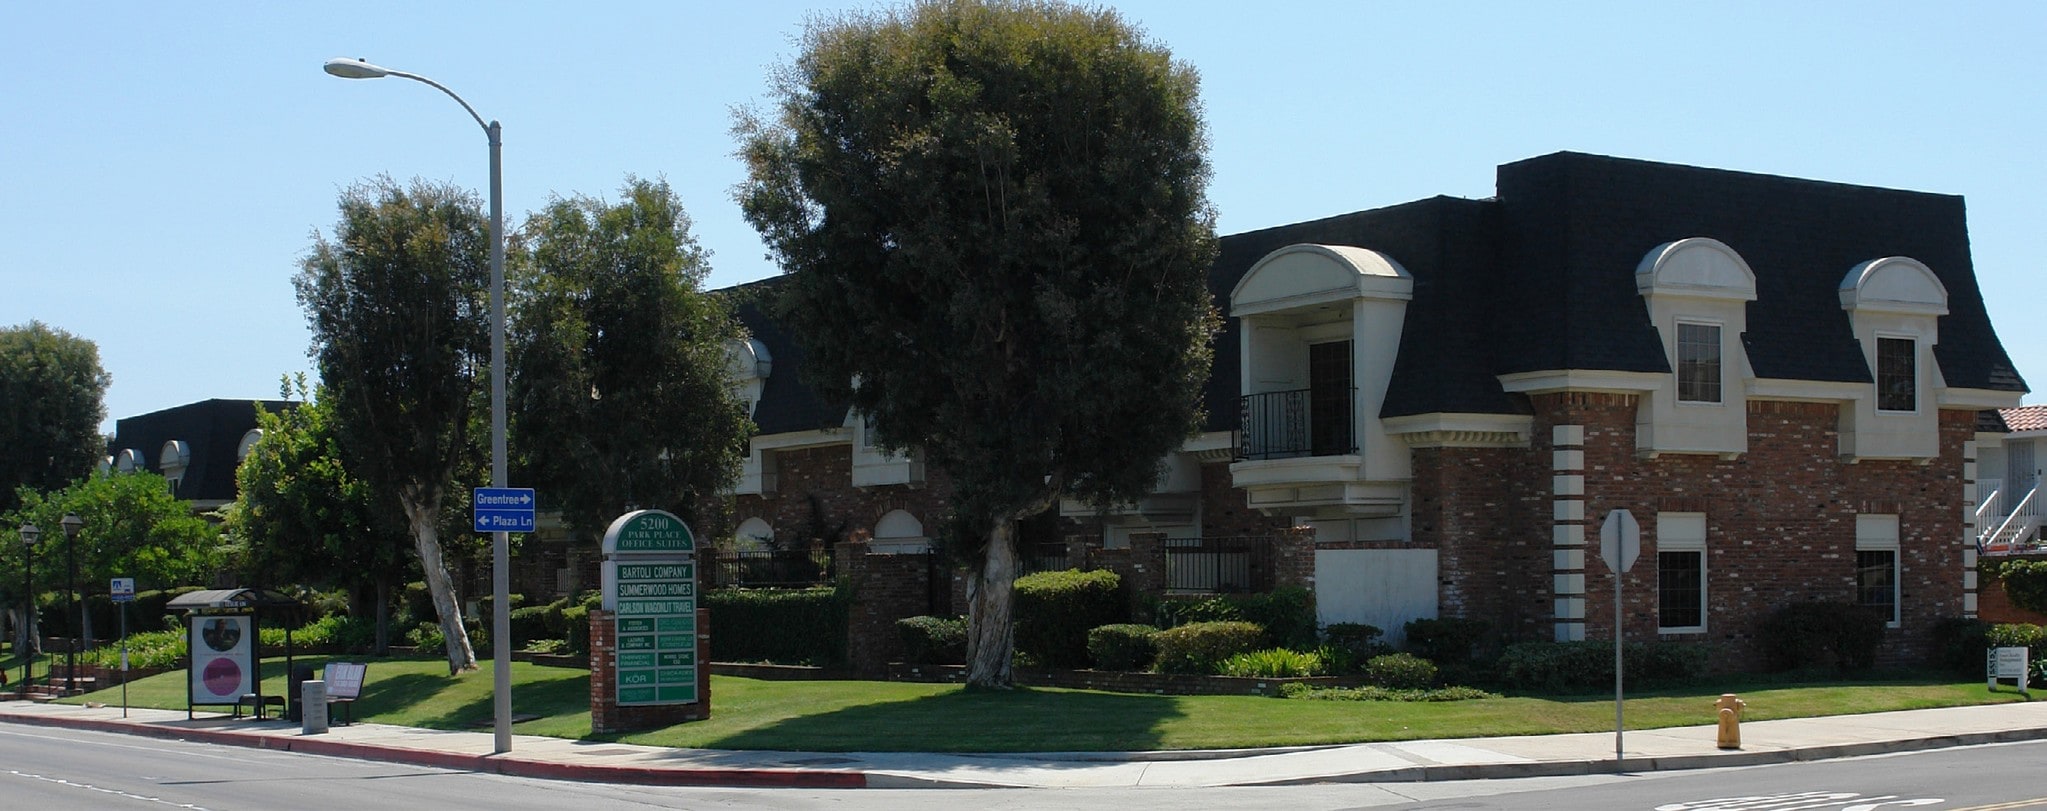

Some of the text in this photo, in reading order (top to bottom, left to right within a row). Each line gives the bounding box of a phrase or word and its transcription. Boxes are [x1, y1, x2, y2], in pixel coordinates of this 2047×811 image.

[477, 493, 519, 504] Greentree
[493, 516, 533, 526] Plaza Ln
[640, 518, 669, 530] 5200
[628, 531, 681, 539] PARK PLACE
[622, 540, 687, 548] OFFICE SUITES
[622, 566, 687, 578] BARTOLI COMPANY
[620, 584, 691, 596] SUMMERWOOD HOMES
[619, 602, 692, 614] CARLSON WAGONLIT TRAVEL
